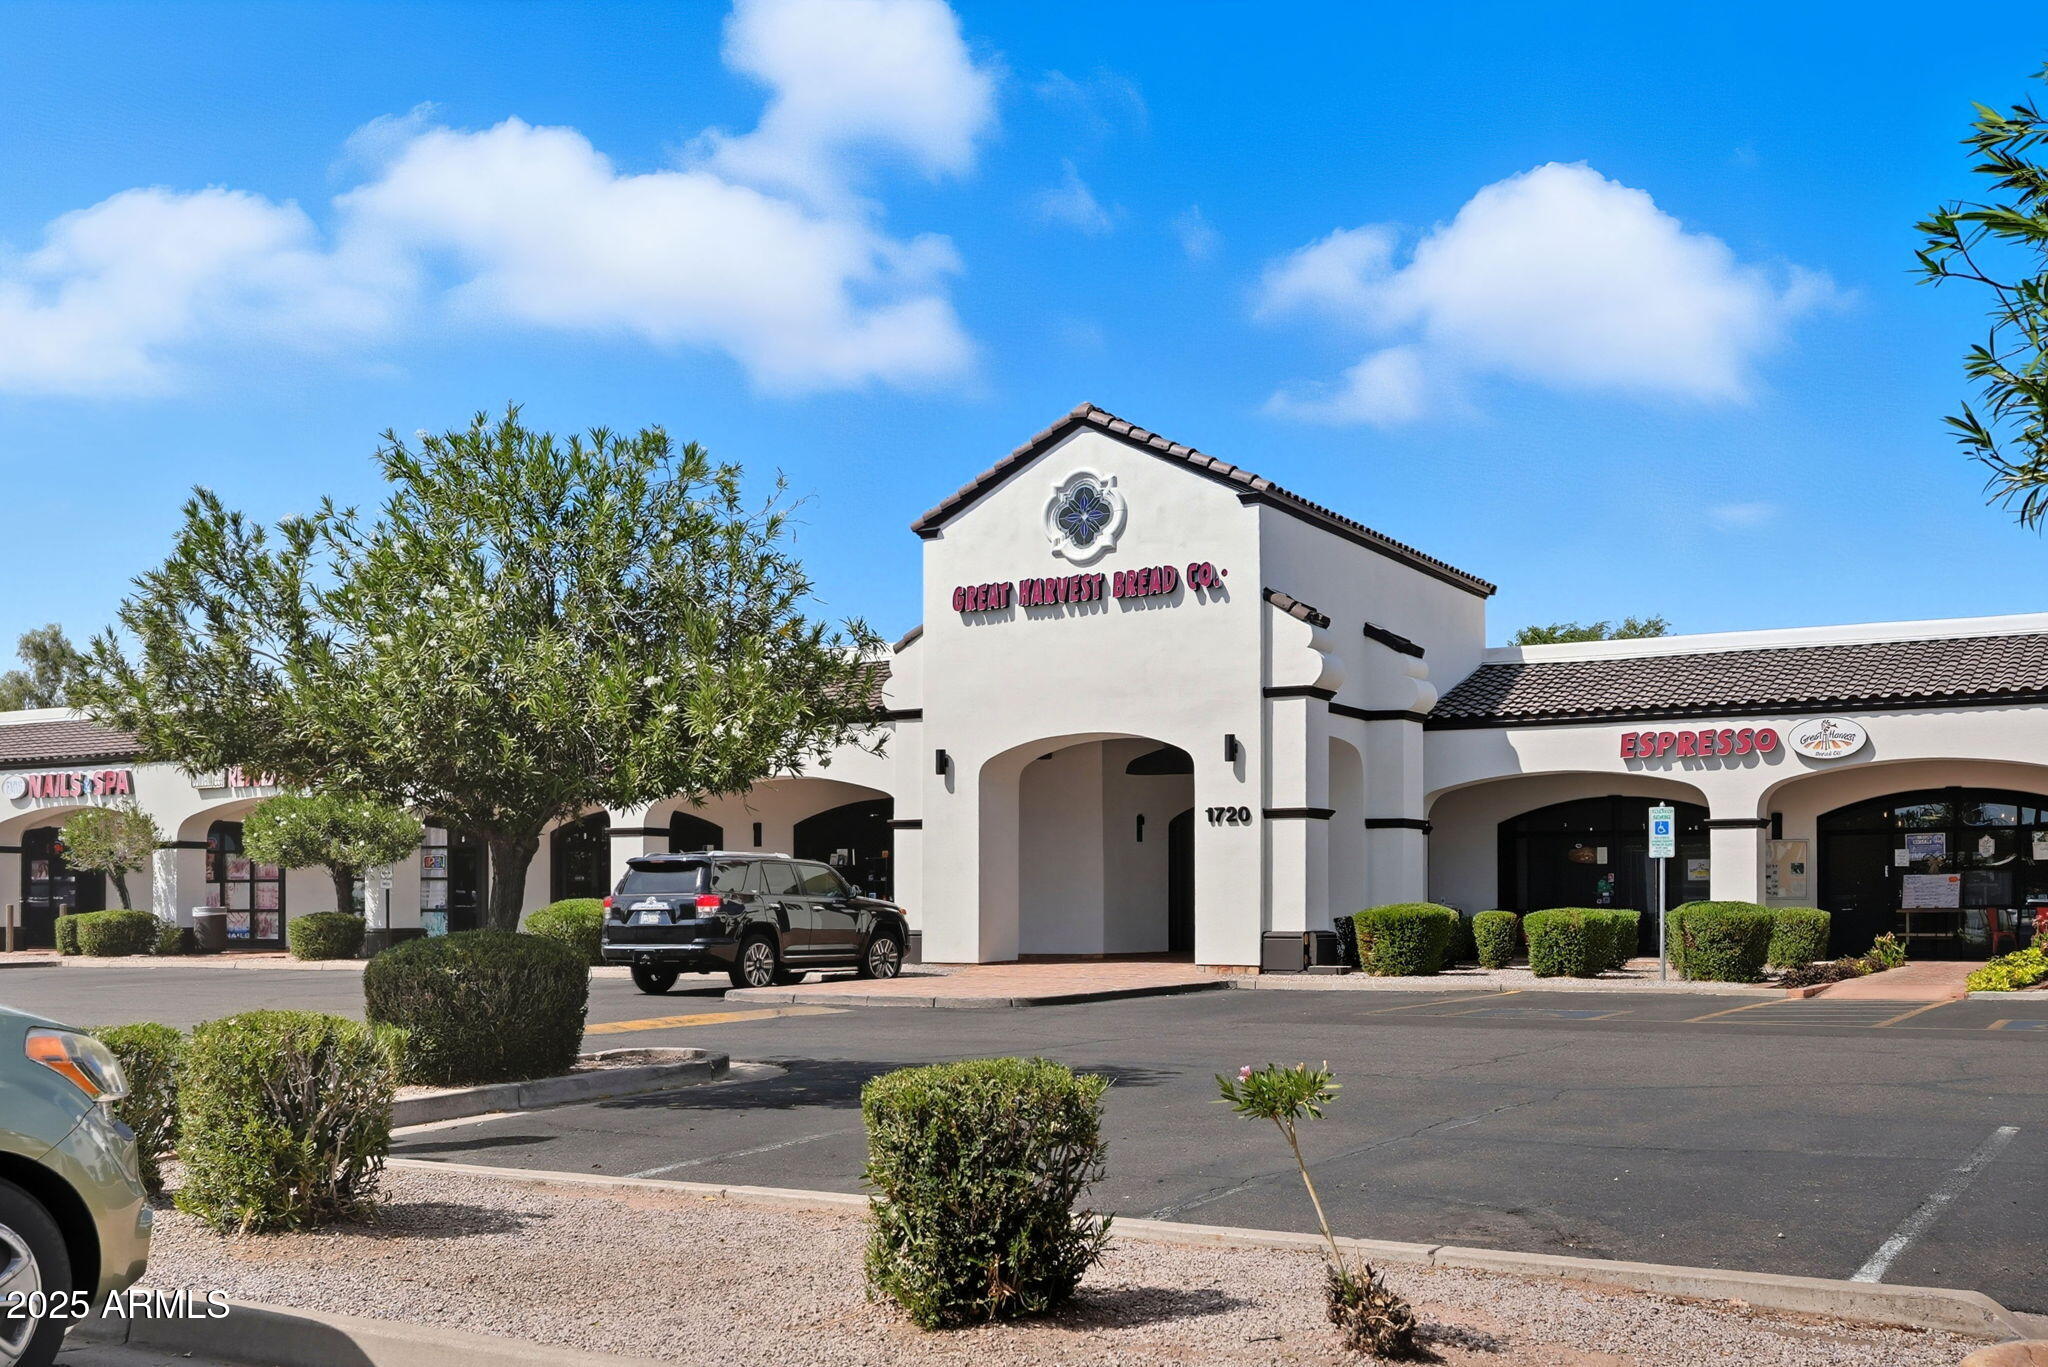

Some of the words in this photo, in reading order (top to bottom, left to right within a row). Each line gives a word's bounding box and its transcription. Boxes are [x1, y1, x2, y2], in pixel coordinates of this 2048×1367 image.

[953, 582, 1010, 612] GREAT
[1018, 573, 1103, 607] HARVEST
[1113, 565, 1178, 598] BREAD
[1620, 728, 1778, 758] ESPRESSO
[1800, 731, 1823, 745] Great
[28, 773, 82, 798] NAILS
[93, 771, 129, 796] SPA
[1205, 806, 1251, 822] 1720
